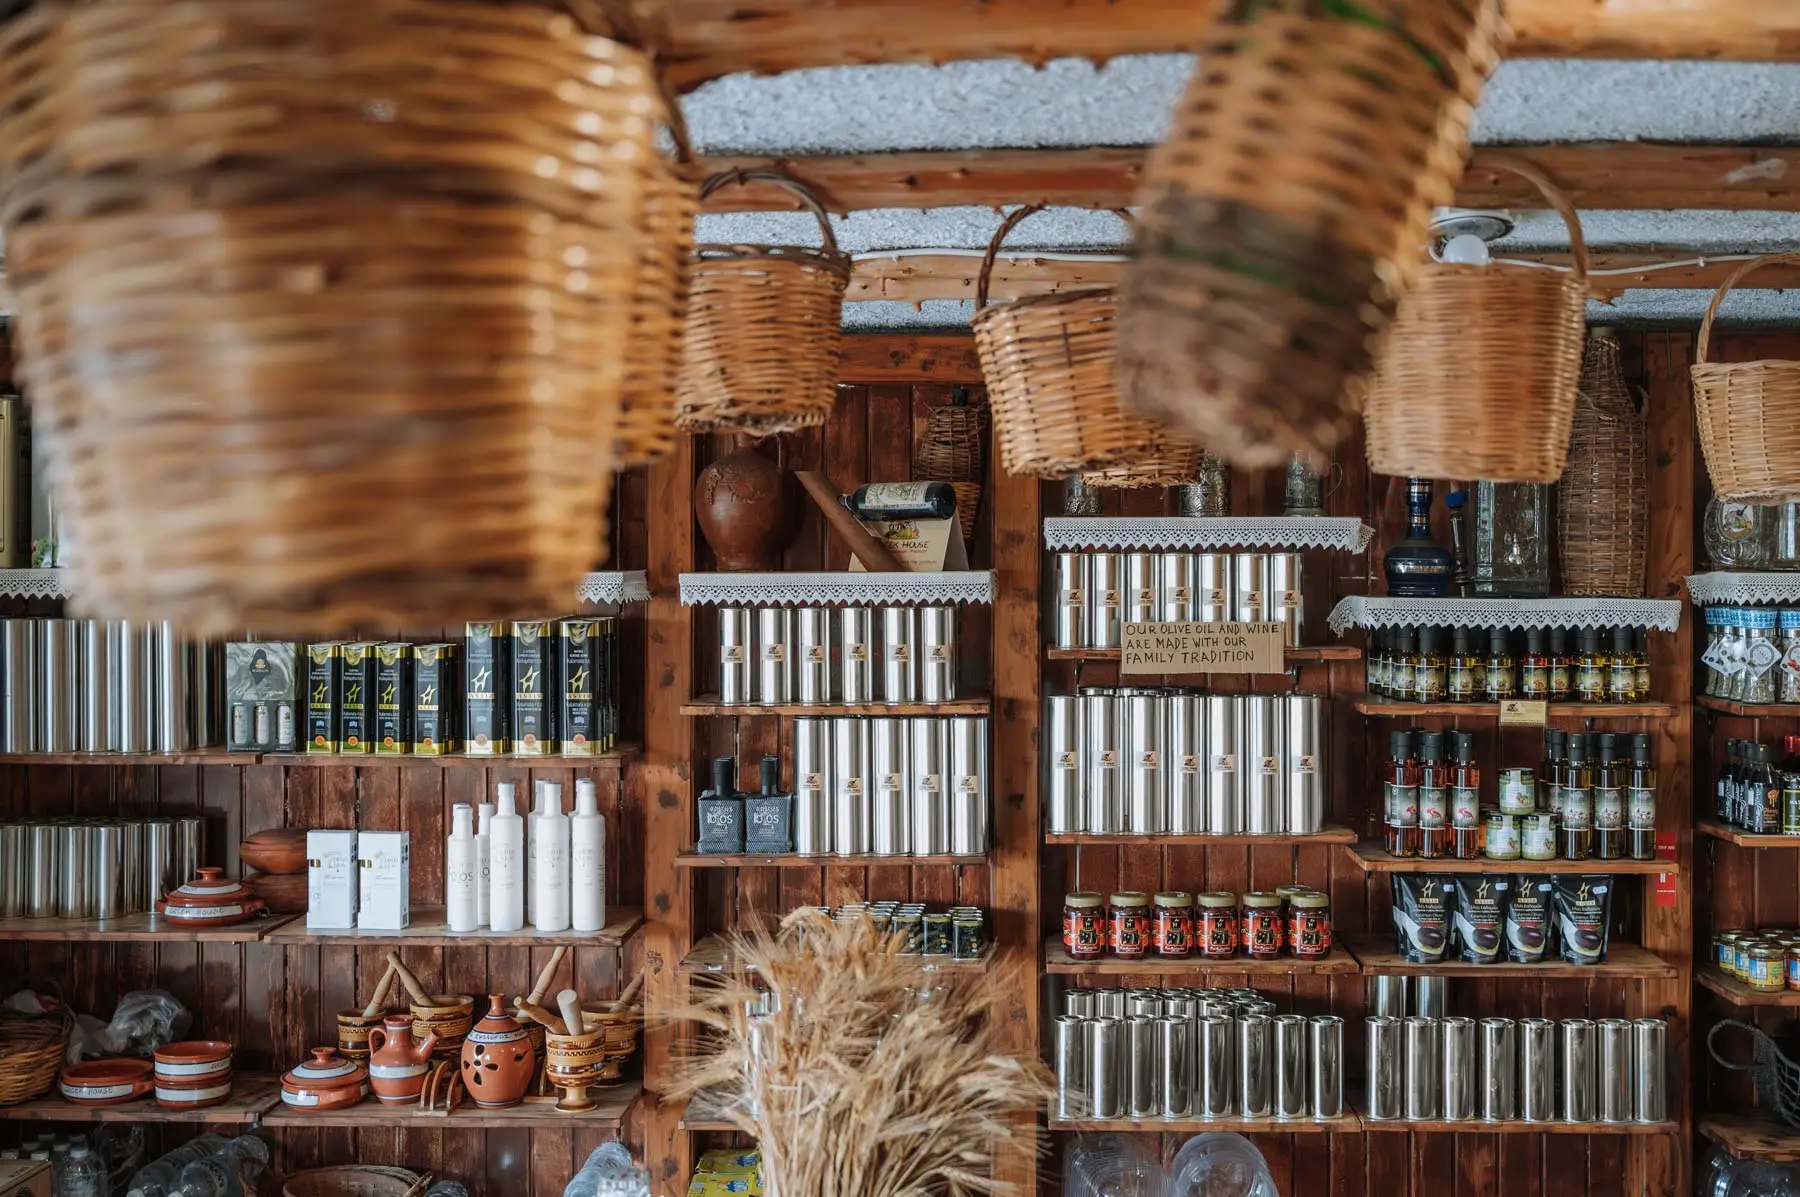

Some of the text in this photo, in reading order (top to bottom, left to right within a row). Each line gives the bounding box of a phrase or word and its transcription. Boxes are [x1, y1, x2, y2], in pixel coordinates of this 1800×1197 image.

[1126, 624, 1279, 635] OUR OLIVE OIL AND WINE
[1126, 636, 1247, 650] ARE MADE WITH OUR
[1126, 650, 1255, 664] FAMILY TRADITION
